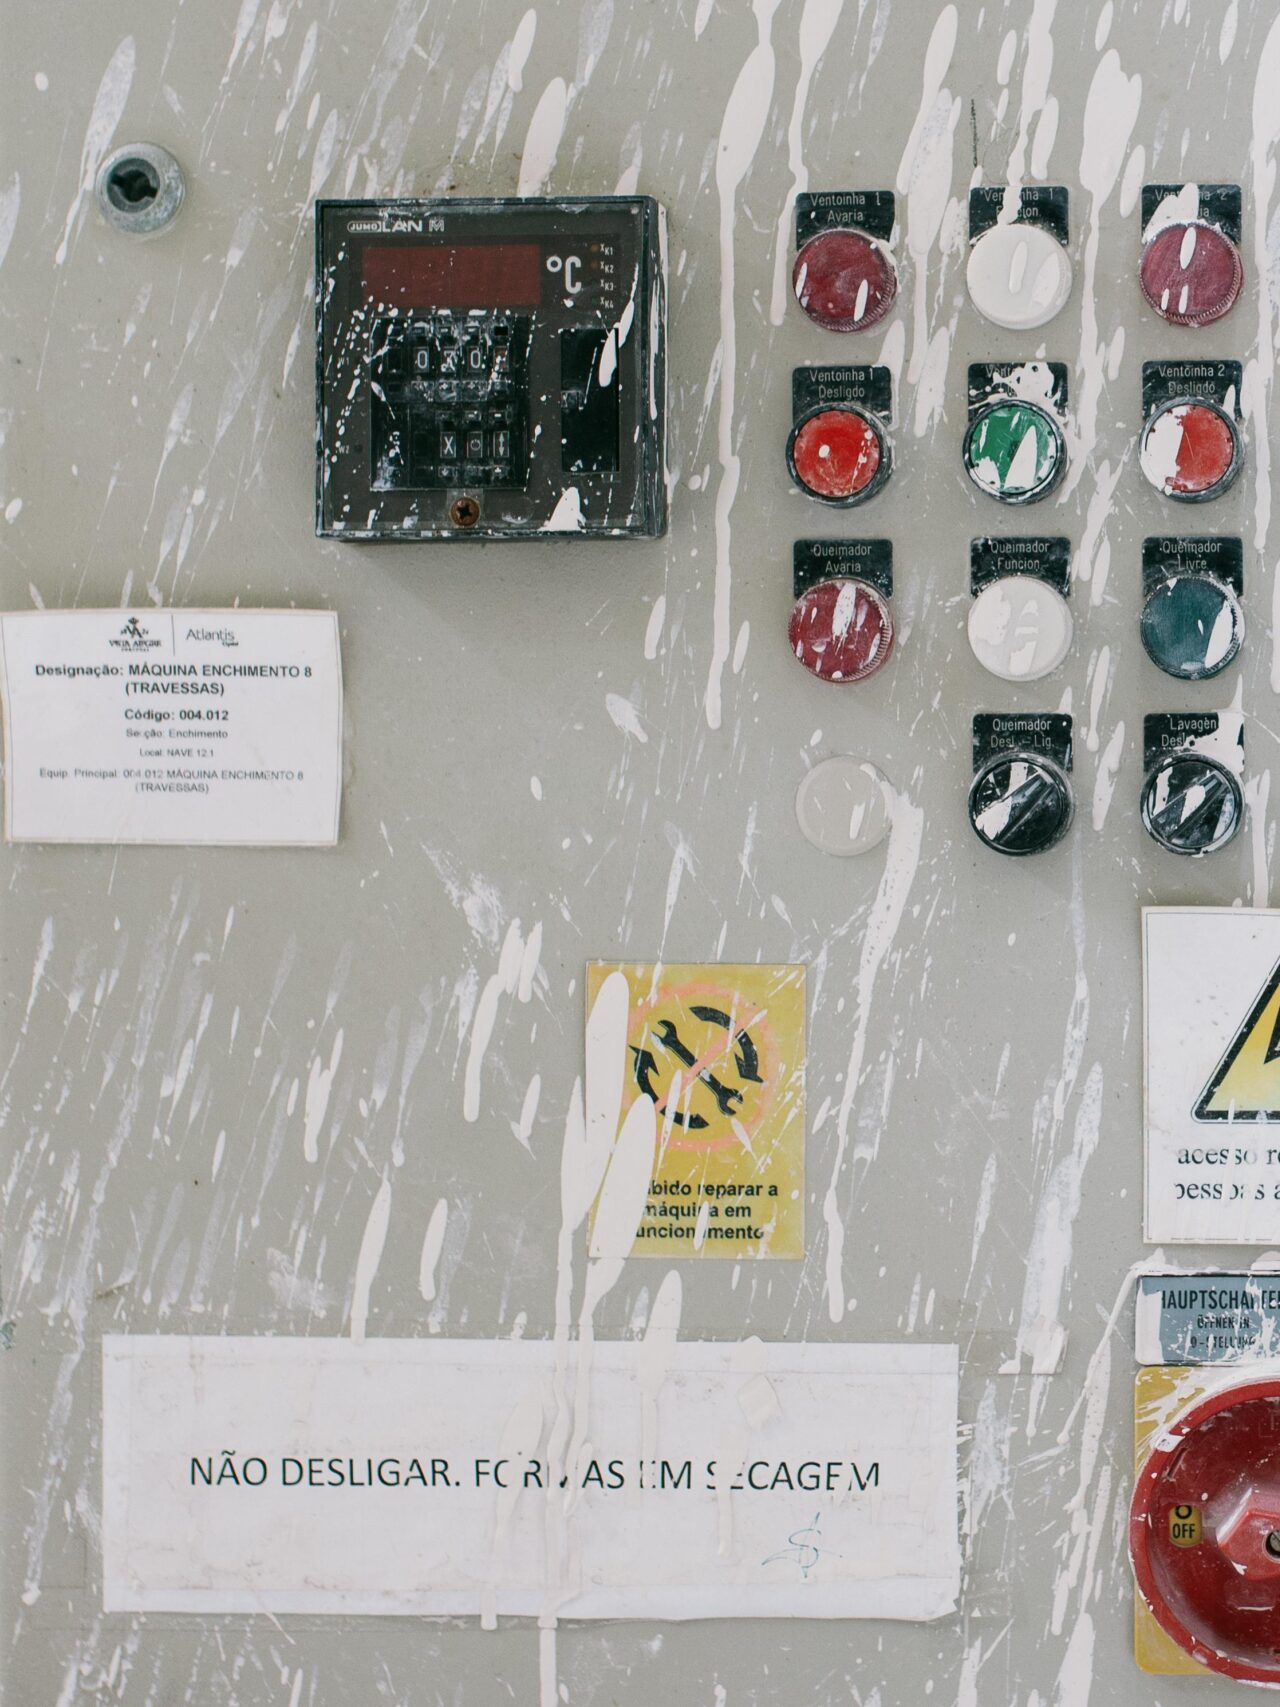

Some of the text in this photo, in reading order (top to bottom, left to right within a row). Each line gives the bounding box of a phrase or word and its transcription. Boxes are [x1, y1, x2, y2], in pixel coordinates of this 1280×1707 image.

[810, 192, 865, 206] Ventoinha
[1049, 188, 1054, 200] 1
[828, 210, 863, 222] Avaria
[546, 255, 582, 294] °C
[809, 368, 874, 382] Ventoinha 1
[1158, 363, 1225, 377] Ventoinha 2
[813, 544, 872, 557] Queimador
[990, 541, 1049, 554] Queimador
[1162, 541, 1222, 554] Queimador
[825, 561, 861, 573] Avaria
[185, 628, 235, 641] Atlantis
[35, 661, 312, 678] Designação: MÁQUINA ENCHIMENTO 8
[125, 682, 225, 696] (TRAVESSAS)
[124, 708, 229, 722] Código: 004.012
[992, 719, 1051, 731] Queimador
[168, 728, 229, 738] Enchimento
[167, 748, 194, 757] NAVE
[167, 767, 218, 779] MÁQUINA
[221, 770, 295, 780] ENCHIMENTO
[135, 783, 209, 794] (TRAVESSAS)
[1177, 1149, 1257, 1165] acesso
[697, 1183, 763, 1199] reparar
[768, 1184, 778, 1196] a
[724, 1205, 751, 1217] em
[190, 1449, 268, 1486] NÃO
[281, 1458, 460, 1487] DESLIGAR.
[1172, 1523, 1196, 1539] OFF
